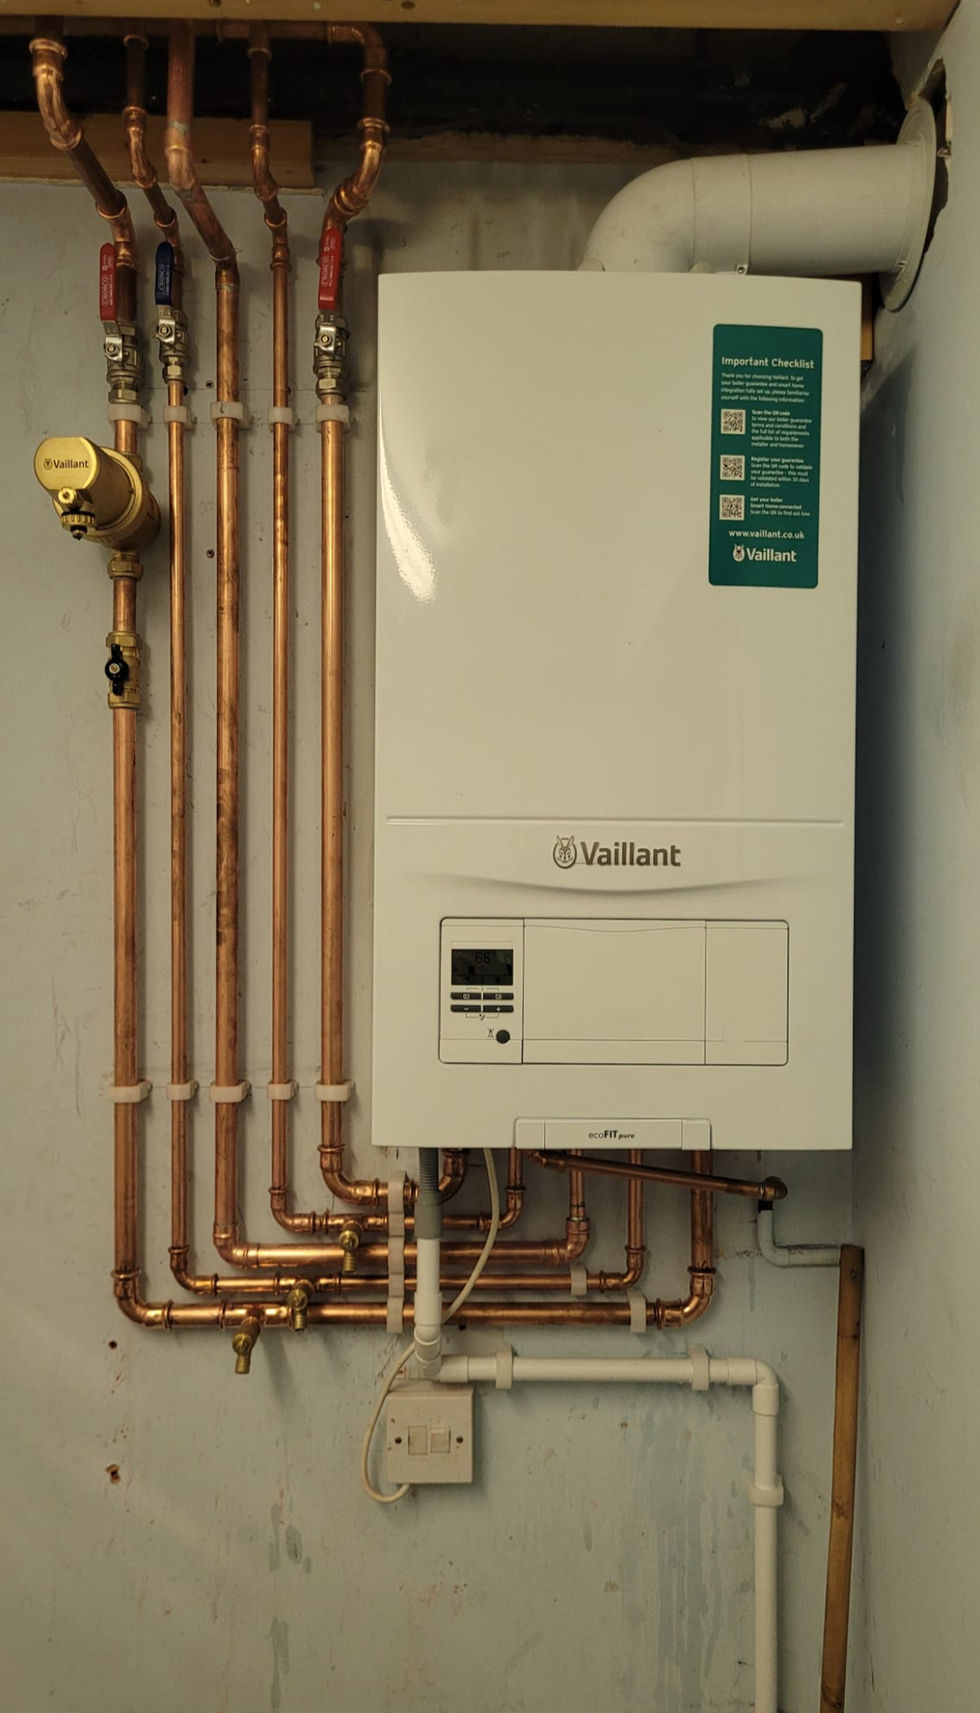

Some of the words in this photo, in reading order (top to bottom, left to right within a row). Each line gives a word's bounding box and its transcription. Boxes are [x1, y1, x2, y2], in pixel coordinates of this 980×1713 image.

[722, 356, 769, 368] Important
[771, 358, 814, 369] Checklist
[53, 460, 89, 468] Vaillant
[728, 530, 804, 539] www.vaillant.co.uk
[746, 547, 797, 562] Vaillant
[580, 841, 681, 867] Vaillant
